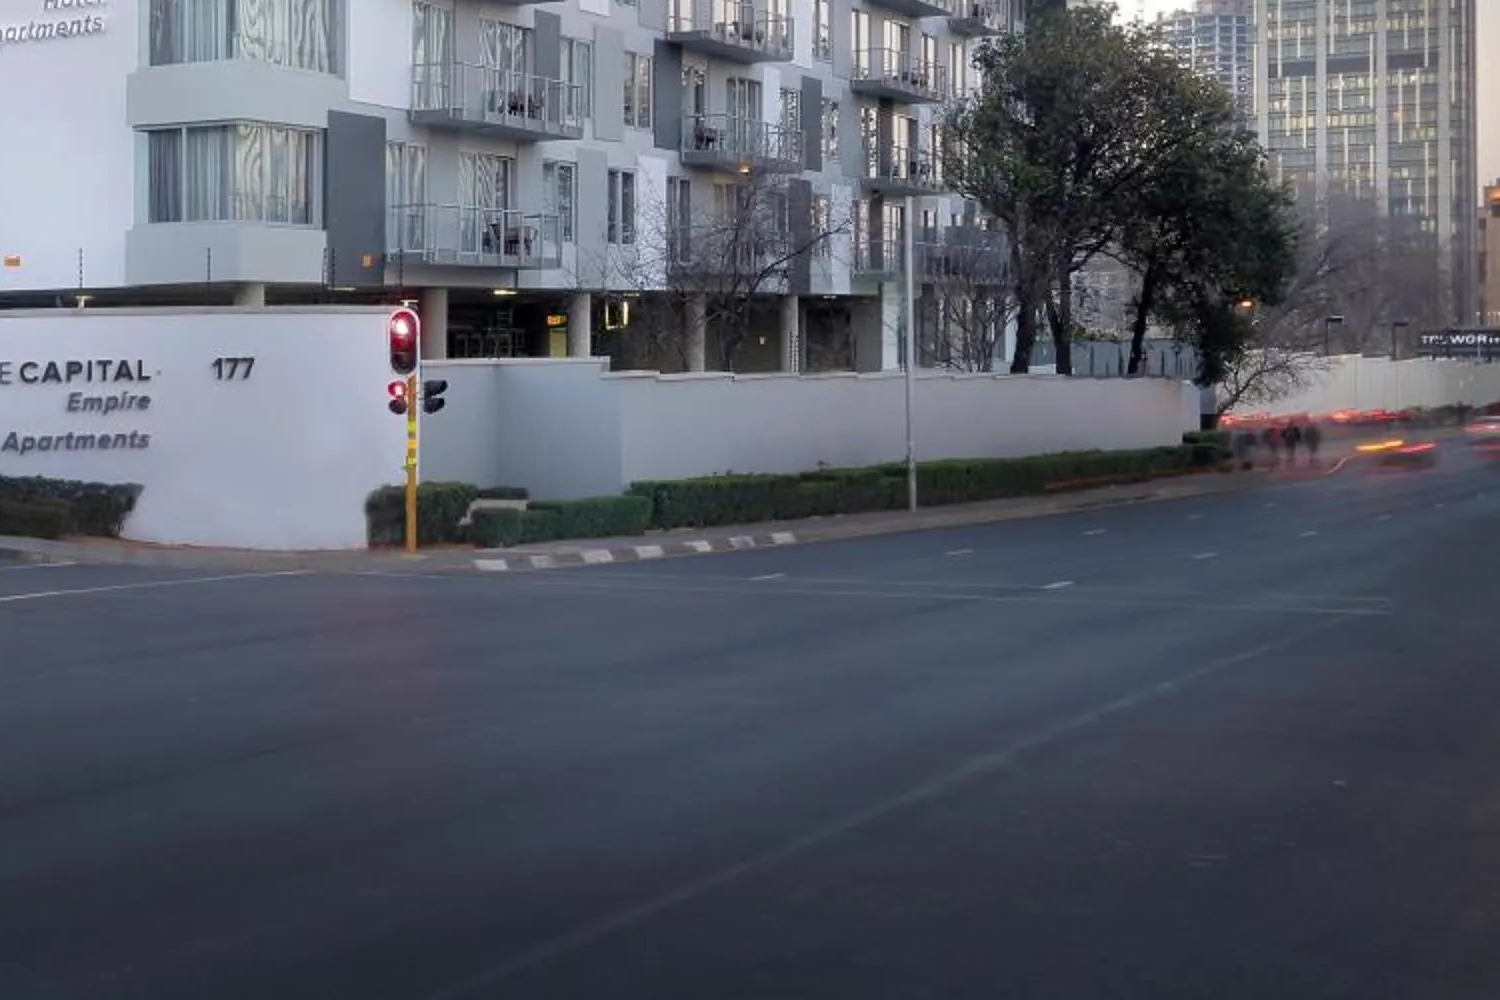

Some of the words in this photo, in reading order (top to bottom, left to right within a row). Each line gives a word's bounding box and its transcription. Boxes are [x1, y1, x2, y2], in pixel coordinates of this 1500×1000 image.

[211, 357, 255, 381] 177
[66, 391, 152, 416] Empire
[2, 430, 152, 456] Apartments
